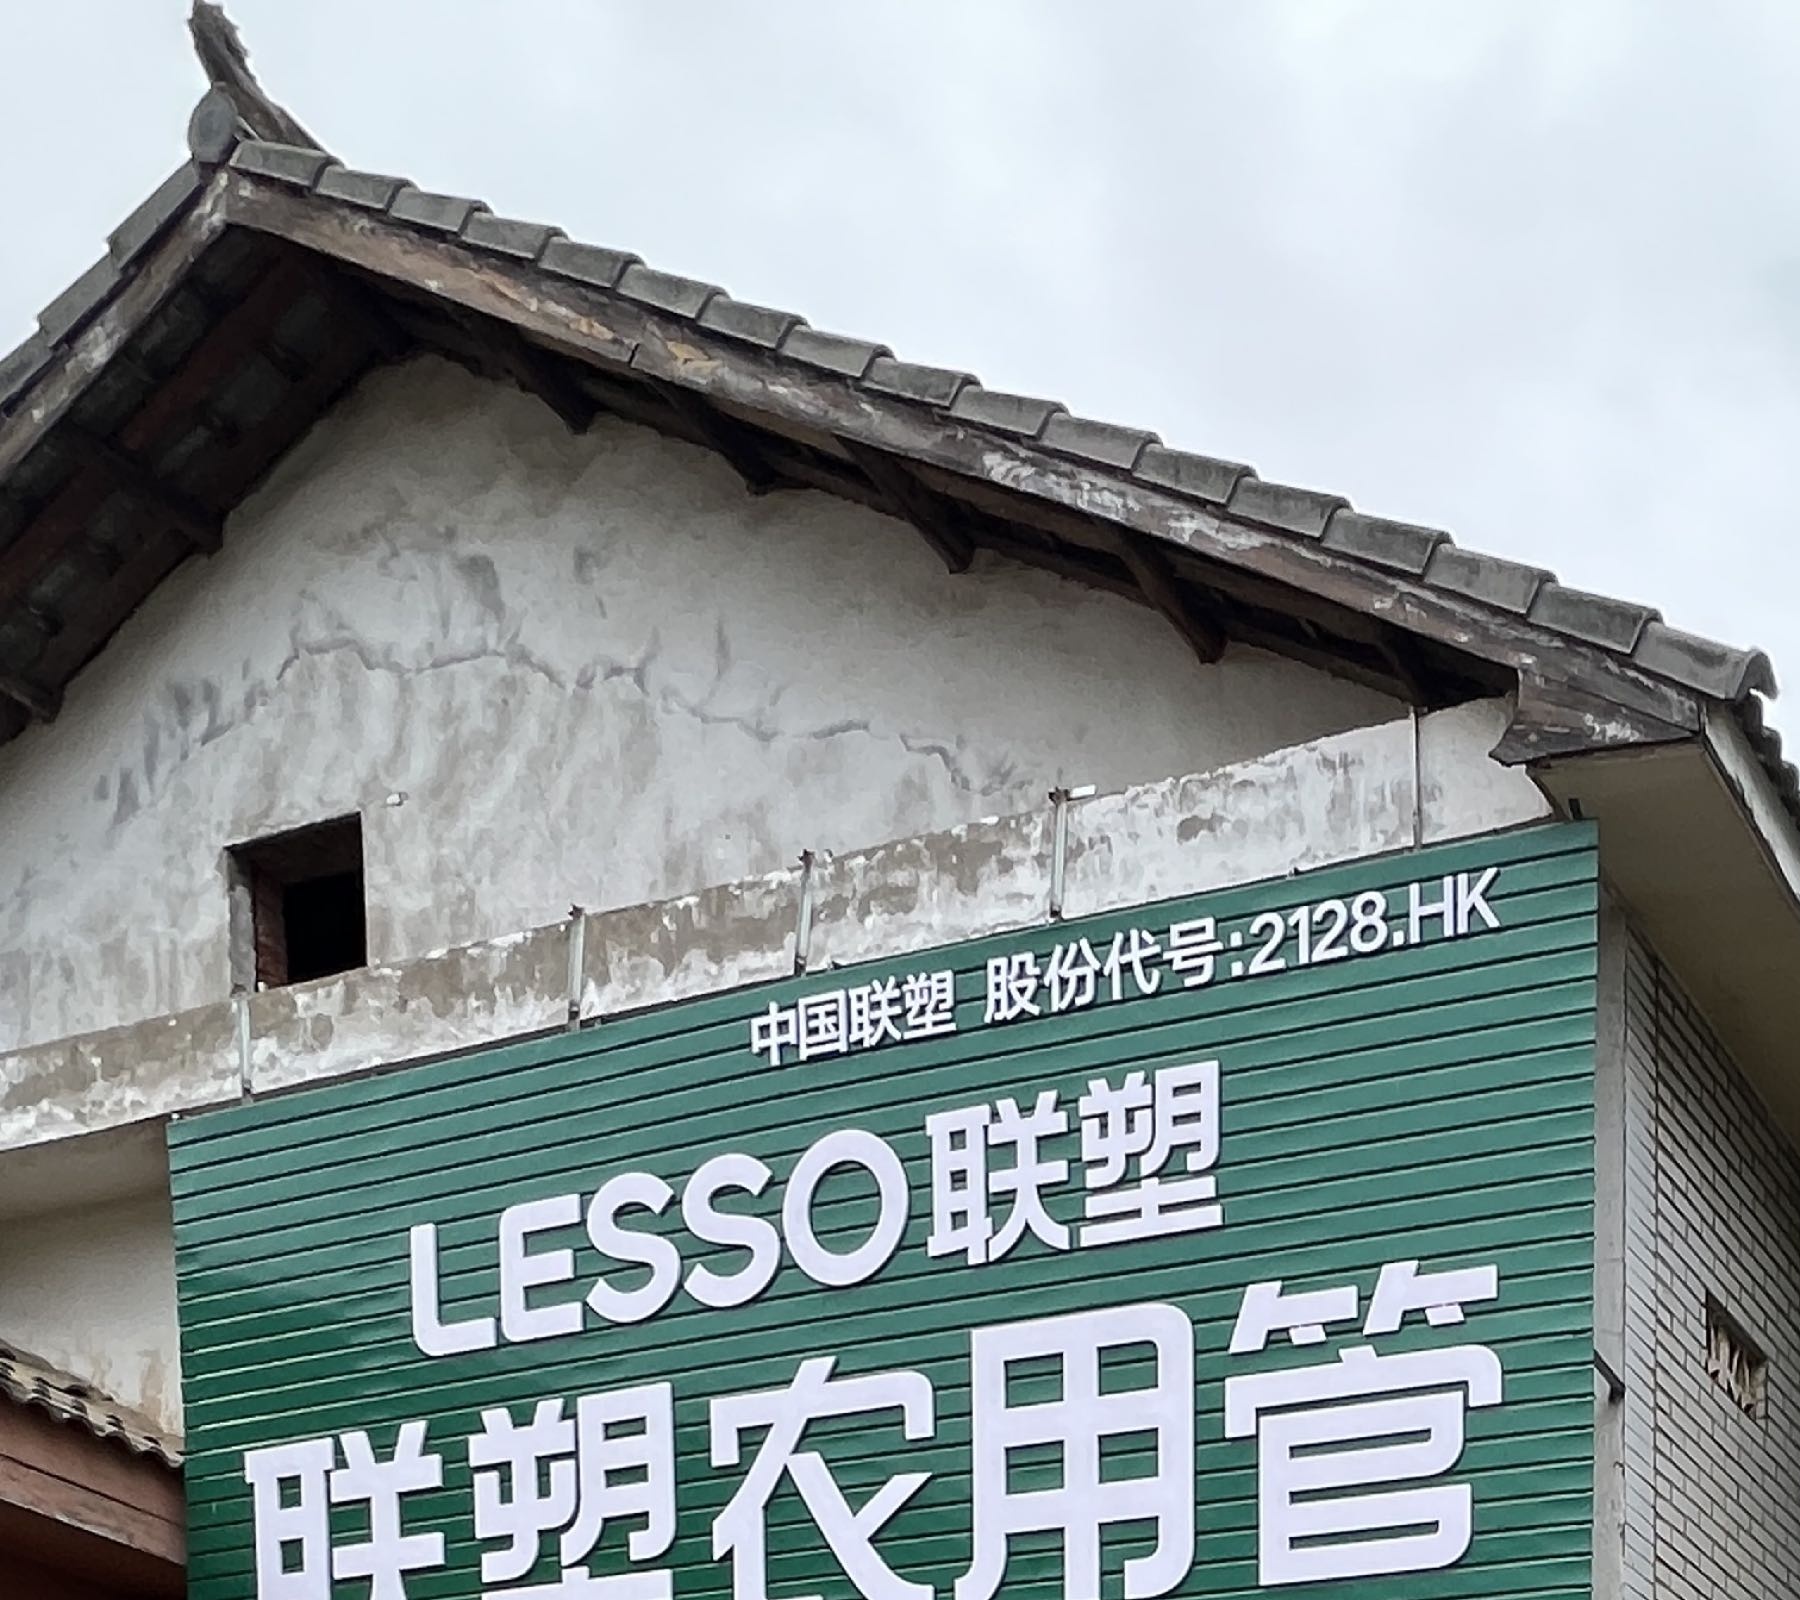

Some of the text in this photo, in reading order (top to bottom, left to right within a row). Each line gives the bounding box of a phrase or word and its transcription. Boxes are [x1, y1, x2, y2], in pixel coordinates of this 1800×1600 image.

[751, 867, 1500, 1067] 中国联塑 股份代号:2128.HK
[409, 1060, 1224, 1357] LESSO联塑
